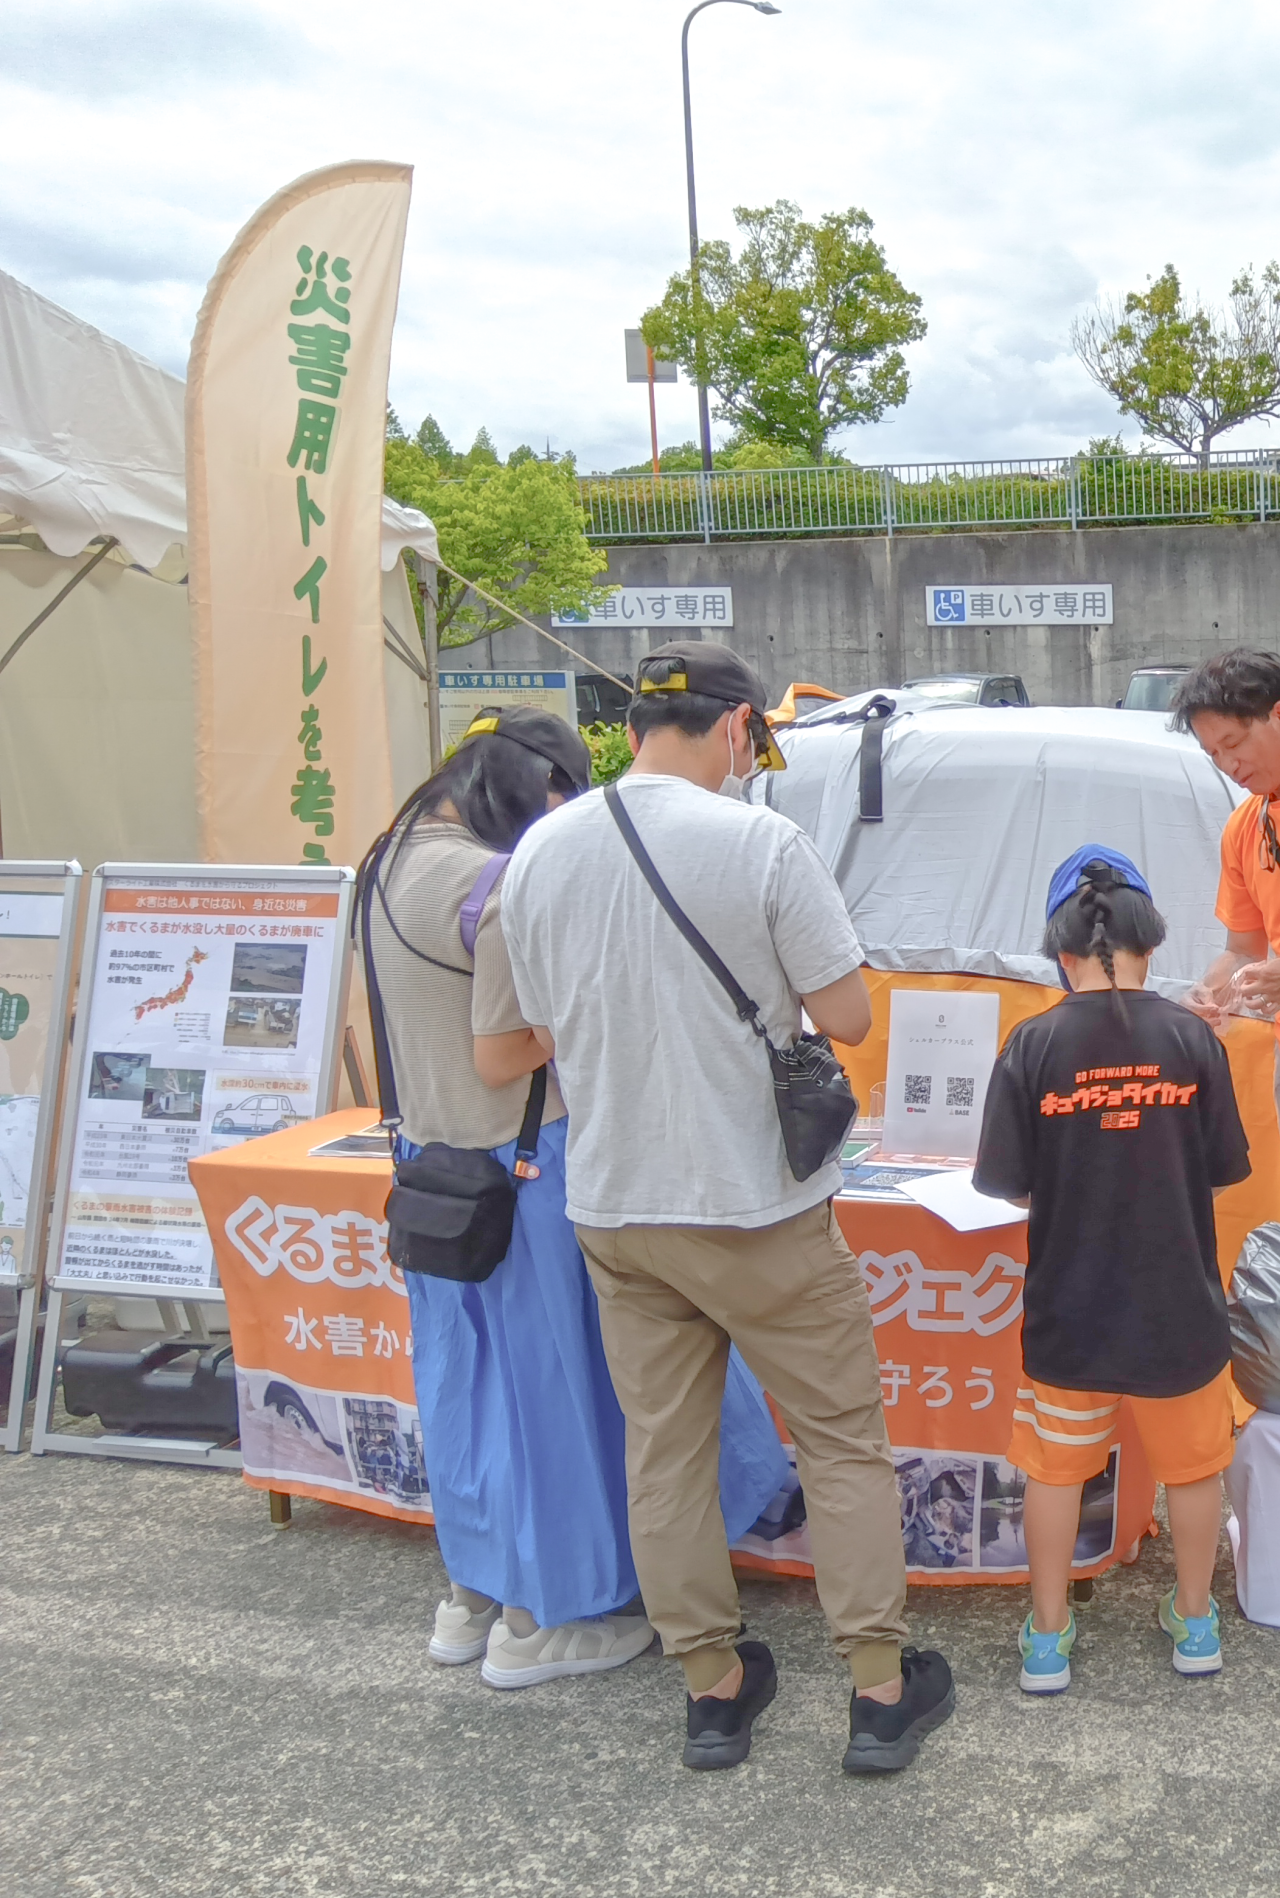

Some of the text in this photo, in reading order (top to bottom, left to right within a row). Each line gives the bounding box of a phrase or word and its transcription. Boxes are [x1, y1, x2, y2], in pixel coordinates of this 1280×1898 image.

[593, 593, 727, 621] 車いす専用
[969, 591, 1107, 619] 車いす専用
[444, 674, 545, 687] 車いす専用駐車場
[135, 895, 308, 912] 水害は他人事ではない、身近な災害
[104, 920, 325, 938] 水害でくるまが水没し大量のくるまが廃車に
[109, 949, 163, 960] 過去10年の間に
[106, 975, 143, 985] 水害が発生
[908, 1036, 975, 1047] シェルカープラス公式
[1075, 1064, 1161, 1083] GO FORWARD MORE
[1039, 1080, 1198, 1116] キュウジョタイカイ
[1100, 1110, 1141, 1130] 2025
